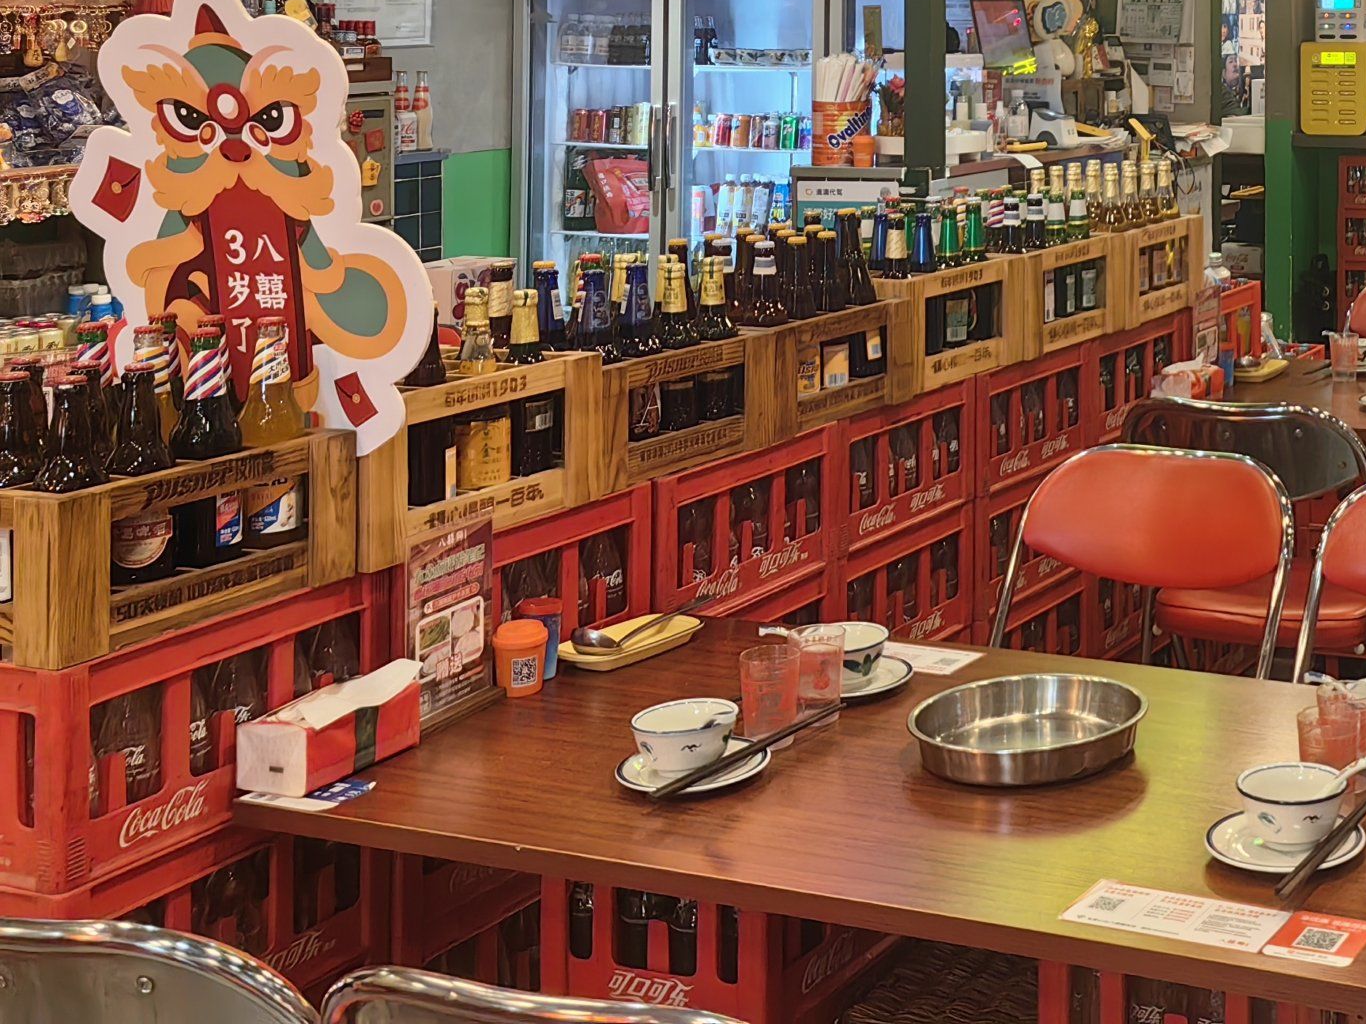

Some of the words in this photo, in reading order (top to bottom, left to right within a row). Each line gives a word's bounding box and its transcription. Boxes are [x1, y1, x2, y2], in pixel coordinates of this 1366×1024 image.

[827, 106, 872, 149] Ovaltin
[224, 229, 252, 354] 3岁了
[252, 233, 288, 311] 八囍
